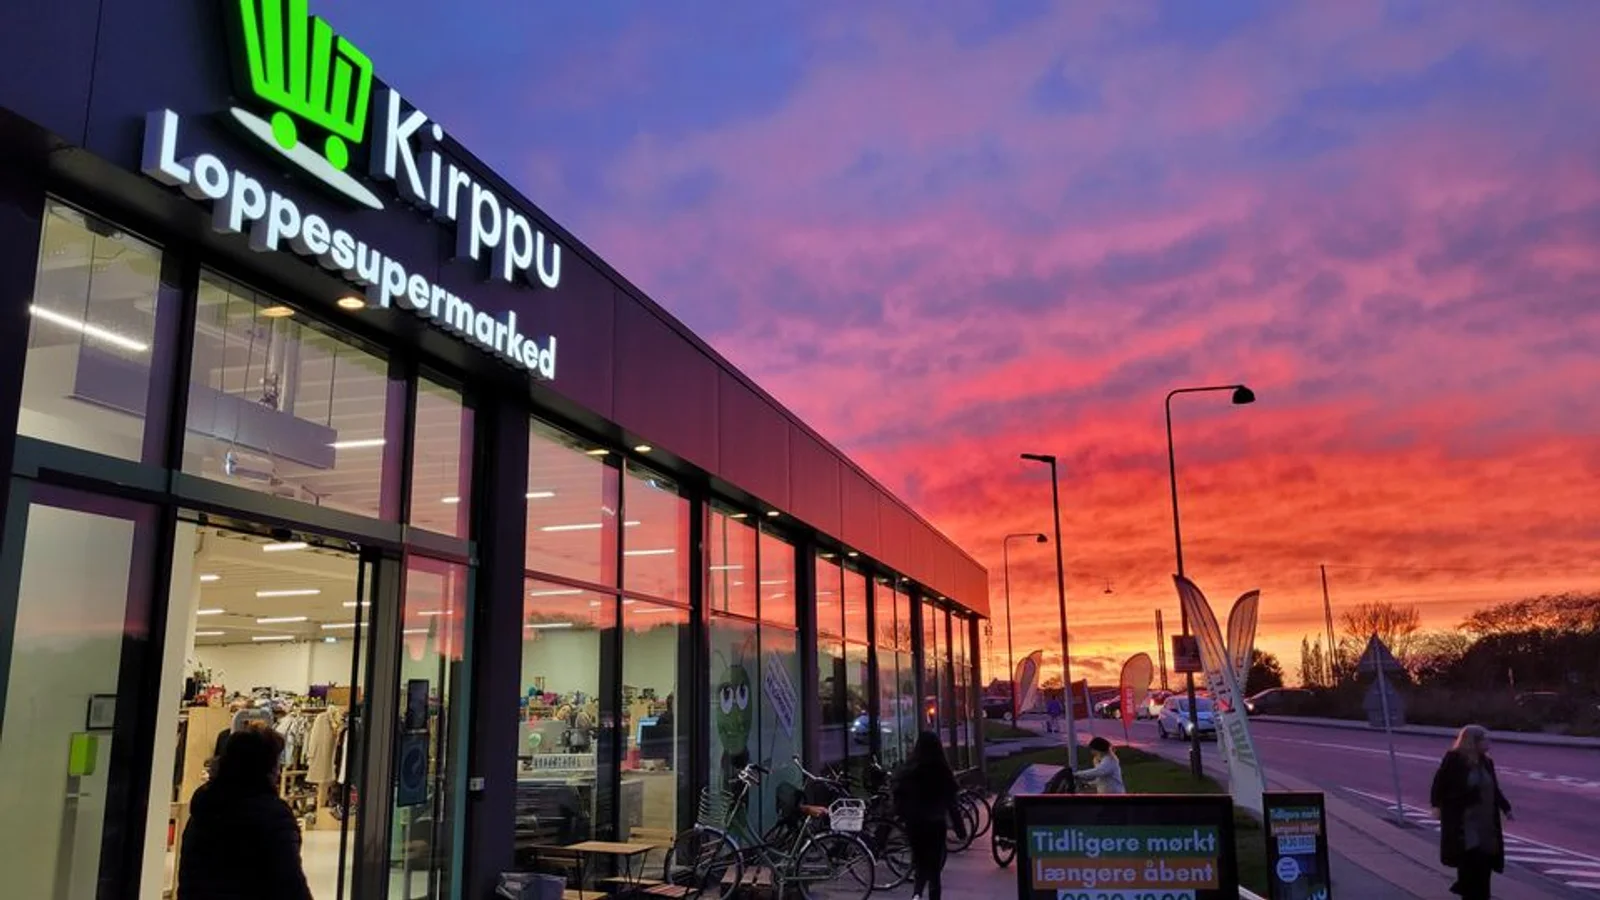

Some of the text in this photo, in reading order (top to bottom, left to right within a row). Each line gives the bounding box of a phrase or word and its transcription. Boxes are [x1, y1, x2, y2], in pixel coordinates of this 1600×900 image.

[158, 107, 556, 380] Loppesupermarked
[383, 88, 561, 289] Kirppu
[1032, 829, 1215, 857] Tidligere mørkt
[1036, 859, 1212, 888] længere åbent
